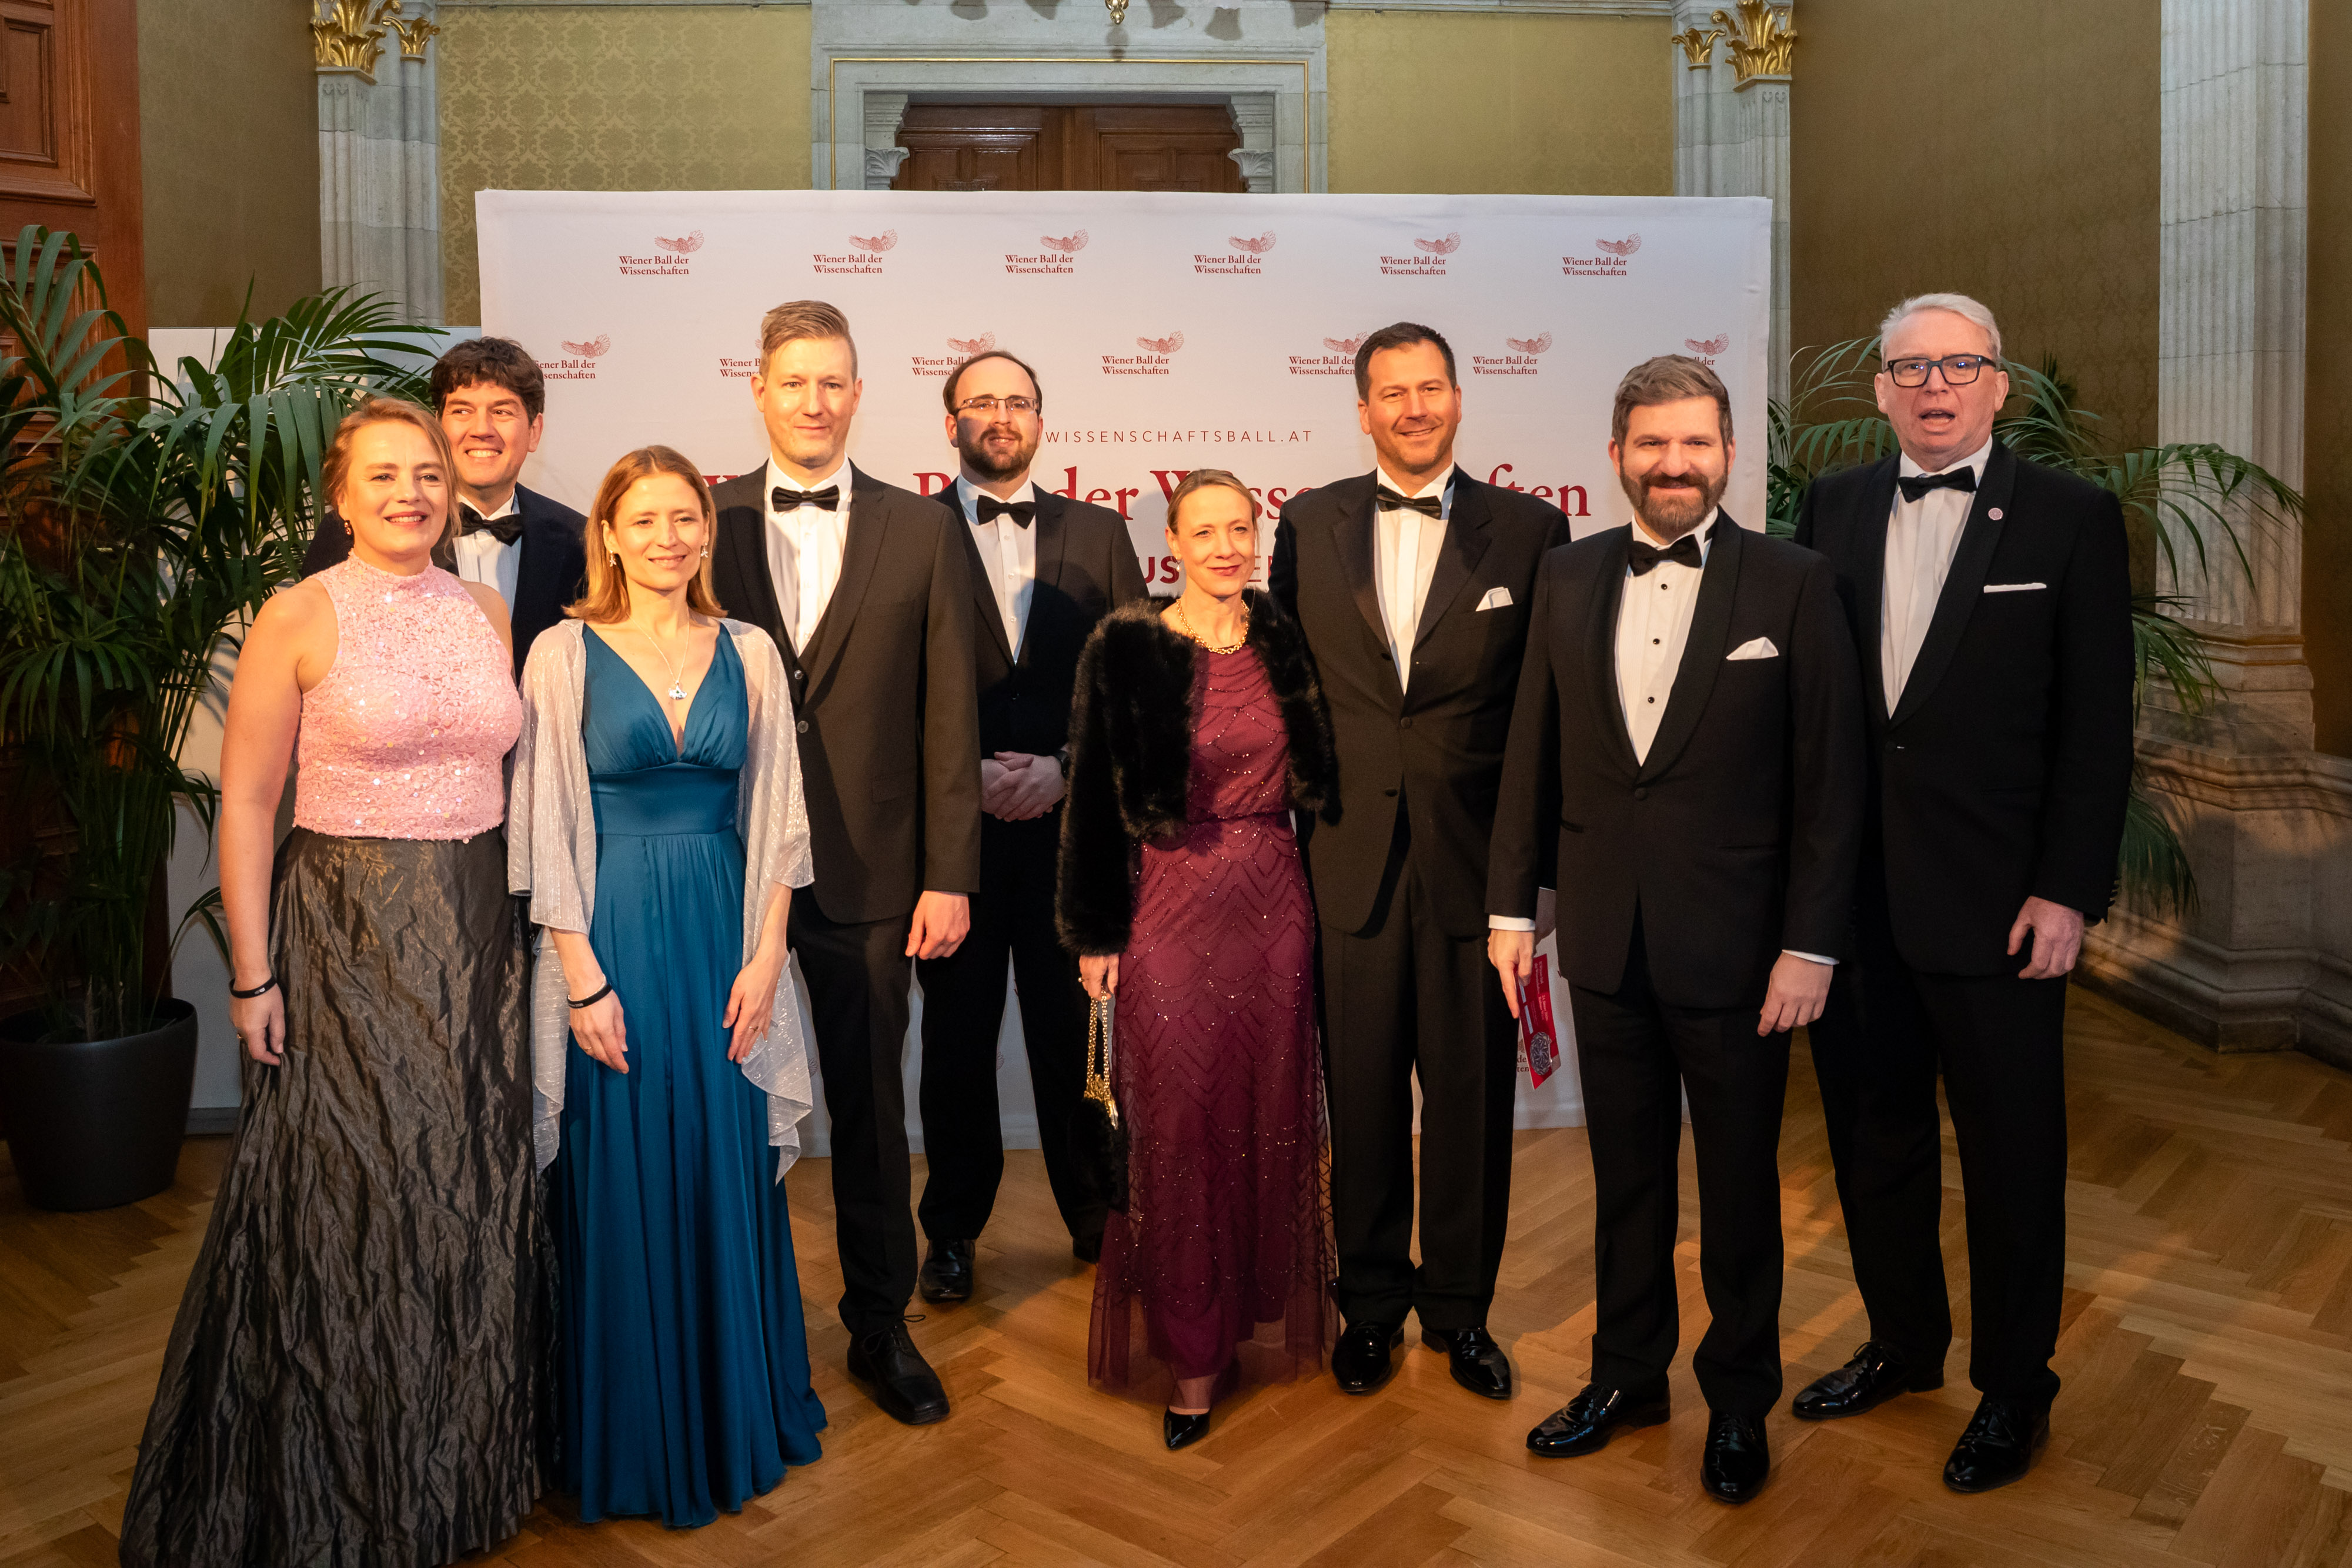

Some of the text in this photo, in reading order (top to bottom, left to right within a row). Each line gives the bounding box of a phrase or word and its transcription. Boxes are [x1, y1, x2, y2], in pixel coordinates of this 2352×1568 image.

[619, 255, 689, 265] Wiener Ball der
[813, 253, 883, 263] Wiener Ball der
[1004, 253, 1074, 263] Wiener Ball der
[1194, 255, 1262, 264] Wiener Ball der
[1379, 256, 1446, 265] Wiener Ball der
[1562, 256, 1628, 266] Wiener Ball der
[619, 265, 689, 275] Wissenschaften
[813, 264, 883, 273] Wissenschaften
[1004, 264, 1074, 273] Wissenschaften
[1194, 265, 1261, 274] Wissenschaften
[1379, 266, 1446, 275] Wissenschaften
[1562, 266, 1628, 276] Wissenschaften
[536, 359, 596, 369] iener Ball der
[719, 358, 753, 367] Wiener
[911, 357, 945, 366] Wiener
[947, 356, 964, 366] Ball
[1101, 355, 1170, 365] Wiener Ball der
[1288, 356, 1321, 365] Wiener
[1322, 356, 1339, 365] Ball
[1472, 355, 1538, 365] Wiener Ball der
[544, 369, 596, 379] senschaften
[1101, 365, 1170, 375] Wissenschaften
[1288, 366, 1355, 375] Wissenschaften
[1472, 365, 1538, 375] Wissenschaften
[1045, 430, 1312, 443] WISSENSCHAFTSBALL.AT
